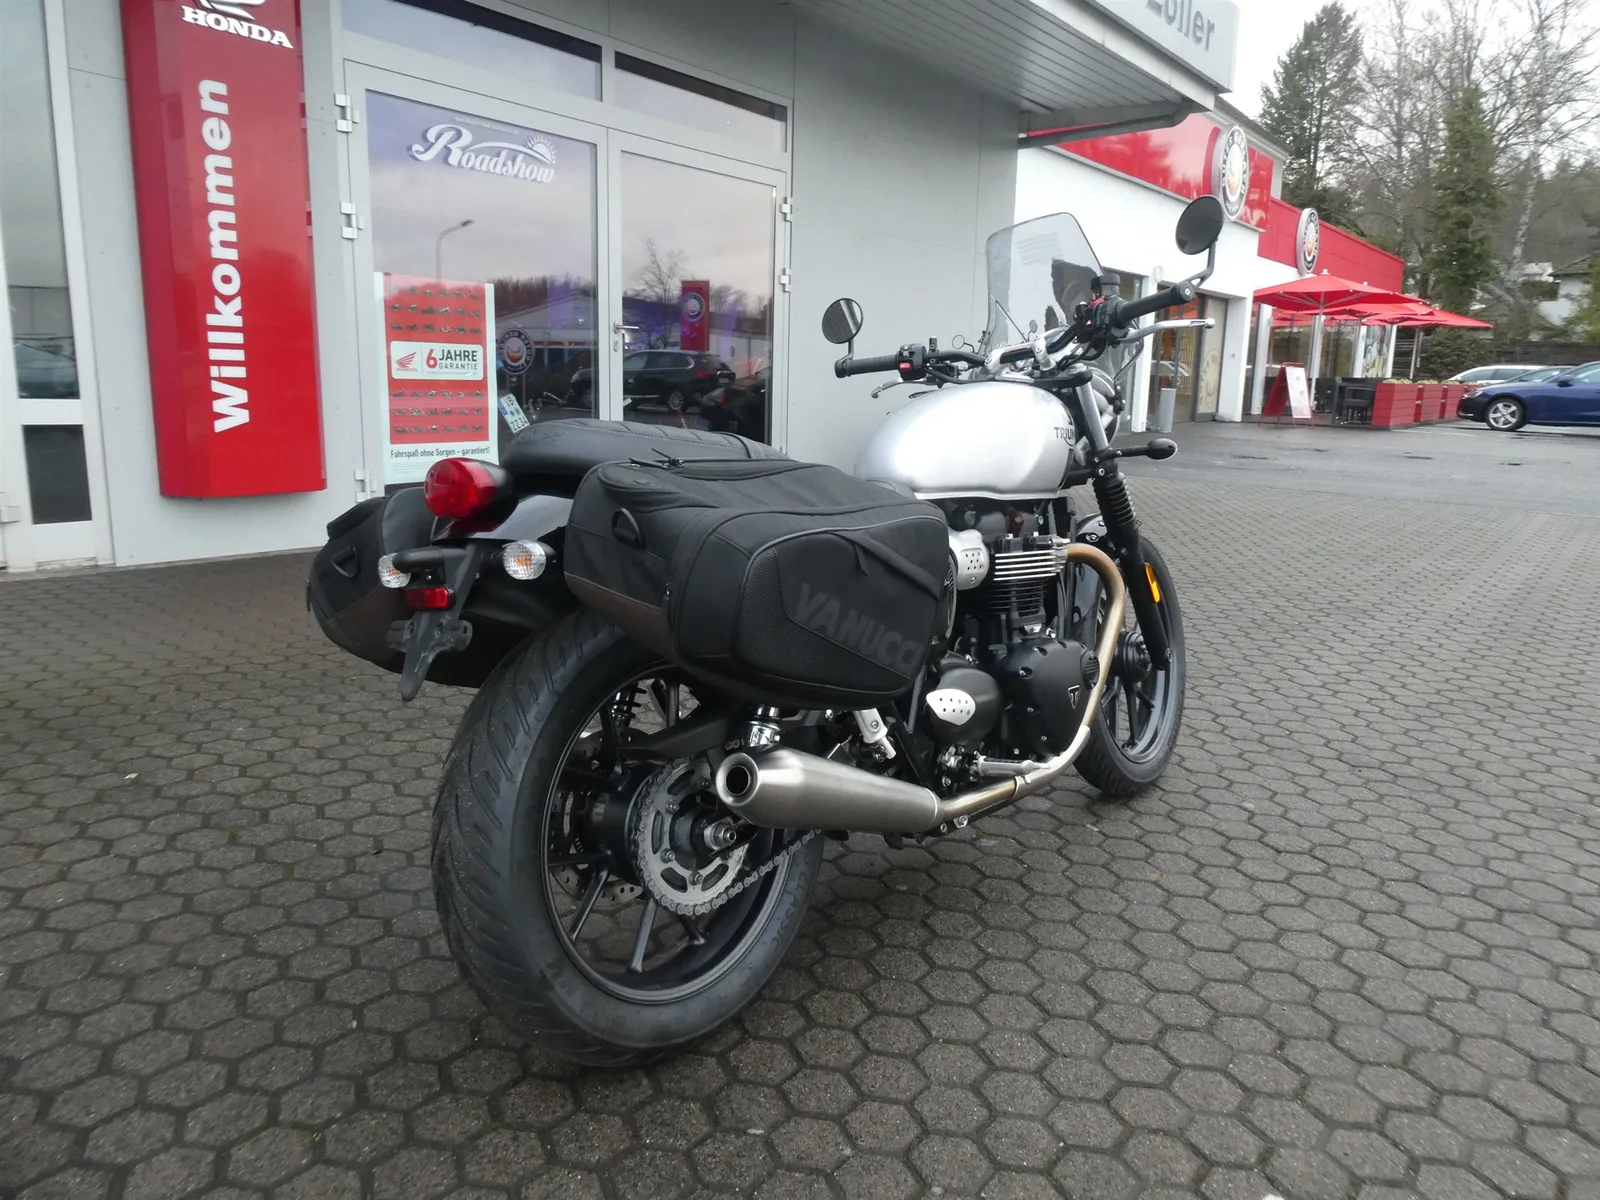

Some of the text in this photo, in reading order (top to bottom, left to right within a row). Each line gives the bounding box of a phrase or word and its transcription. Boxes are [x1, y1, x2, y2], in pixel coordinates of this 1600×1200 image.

[181, 5, 294, 49] HONDA
[1146, 0, 1215, 52] oller
[411, 124, 556, 183] Roadshow
[198, 79, 250, 433] Willkommen
[426, 348, 478, 369] 6 JAHRE
[438, 362, 478, 371] GARANTIE
[390, 448, 419, 459] Fahrspaß
[420, 449, 434, 457] ohne
[435, 447, 456, 458] Sorgen
